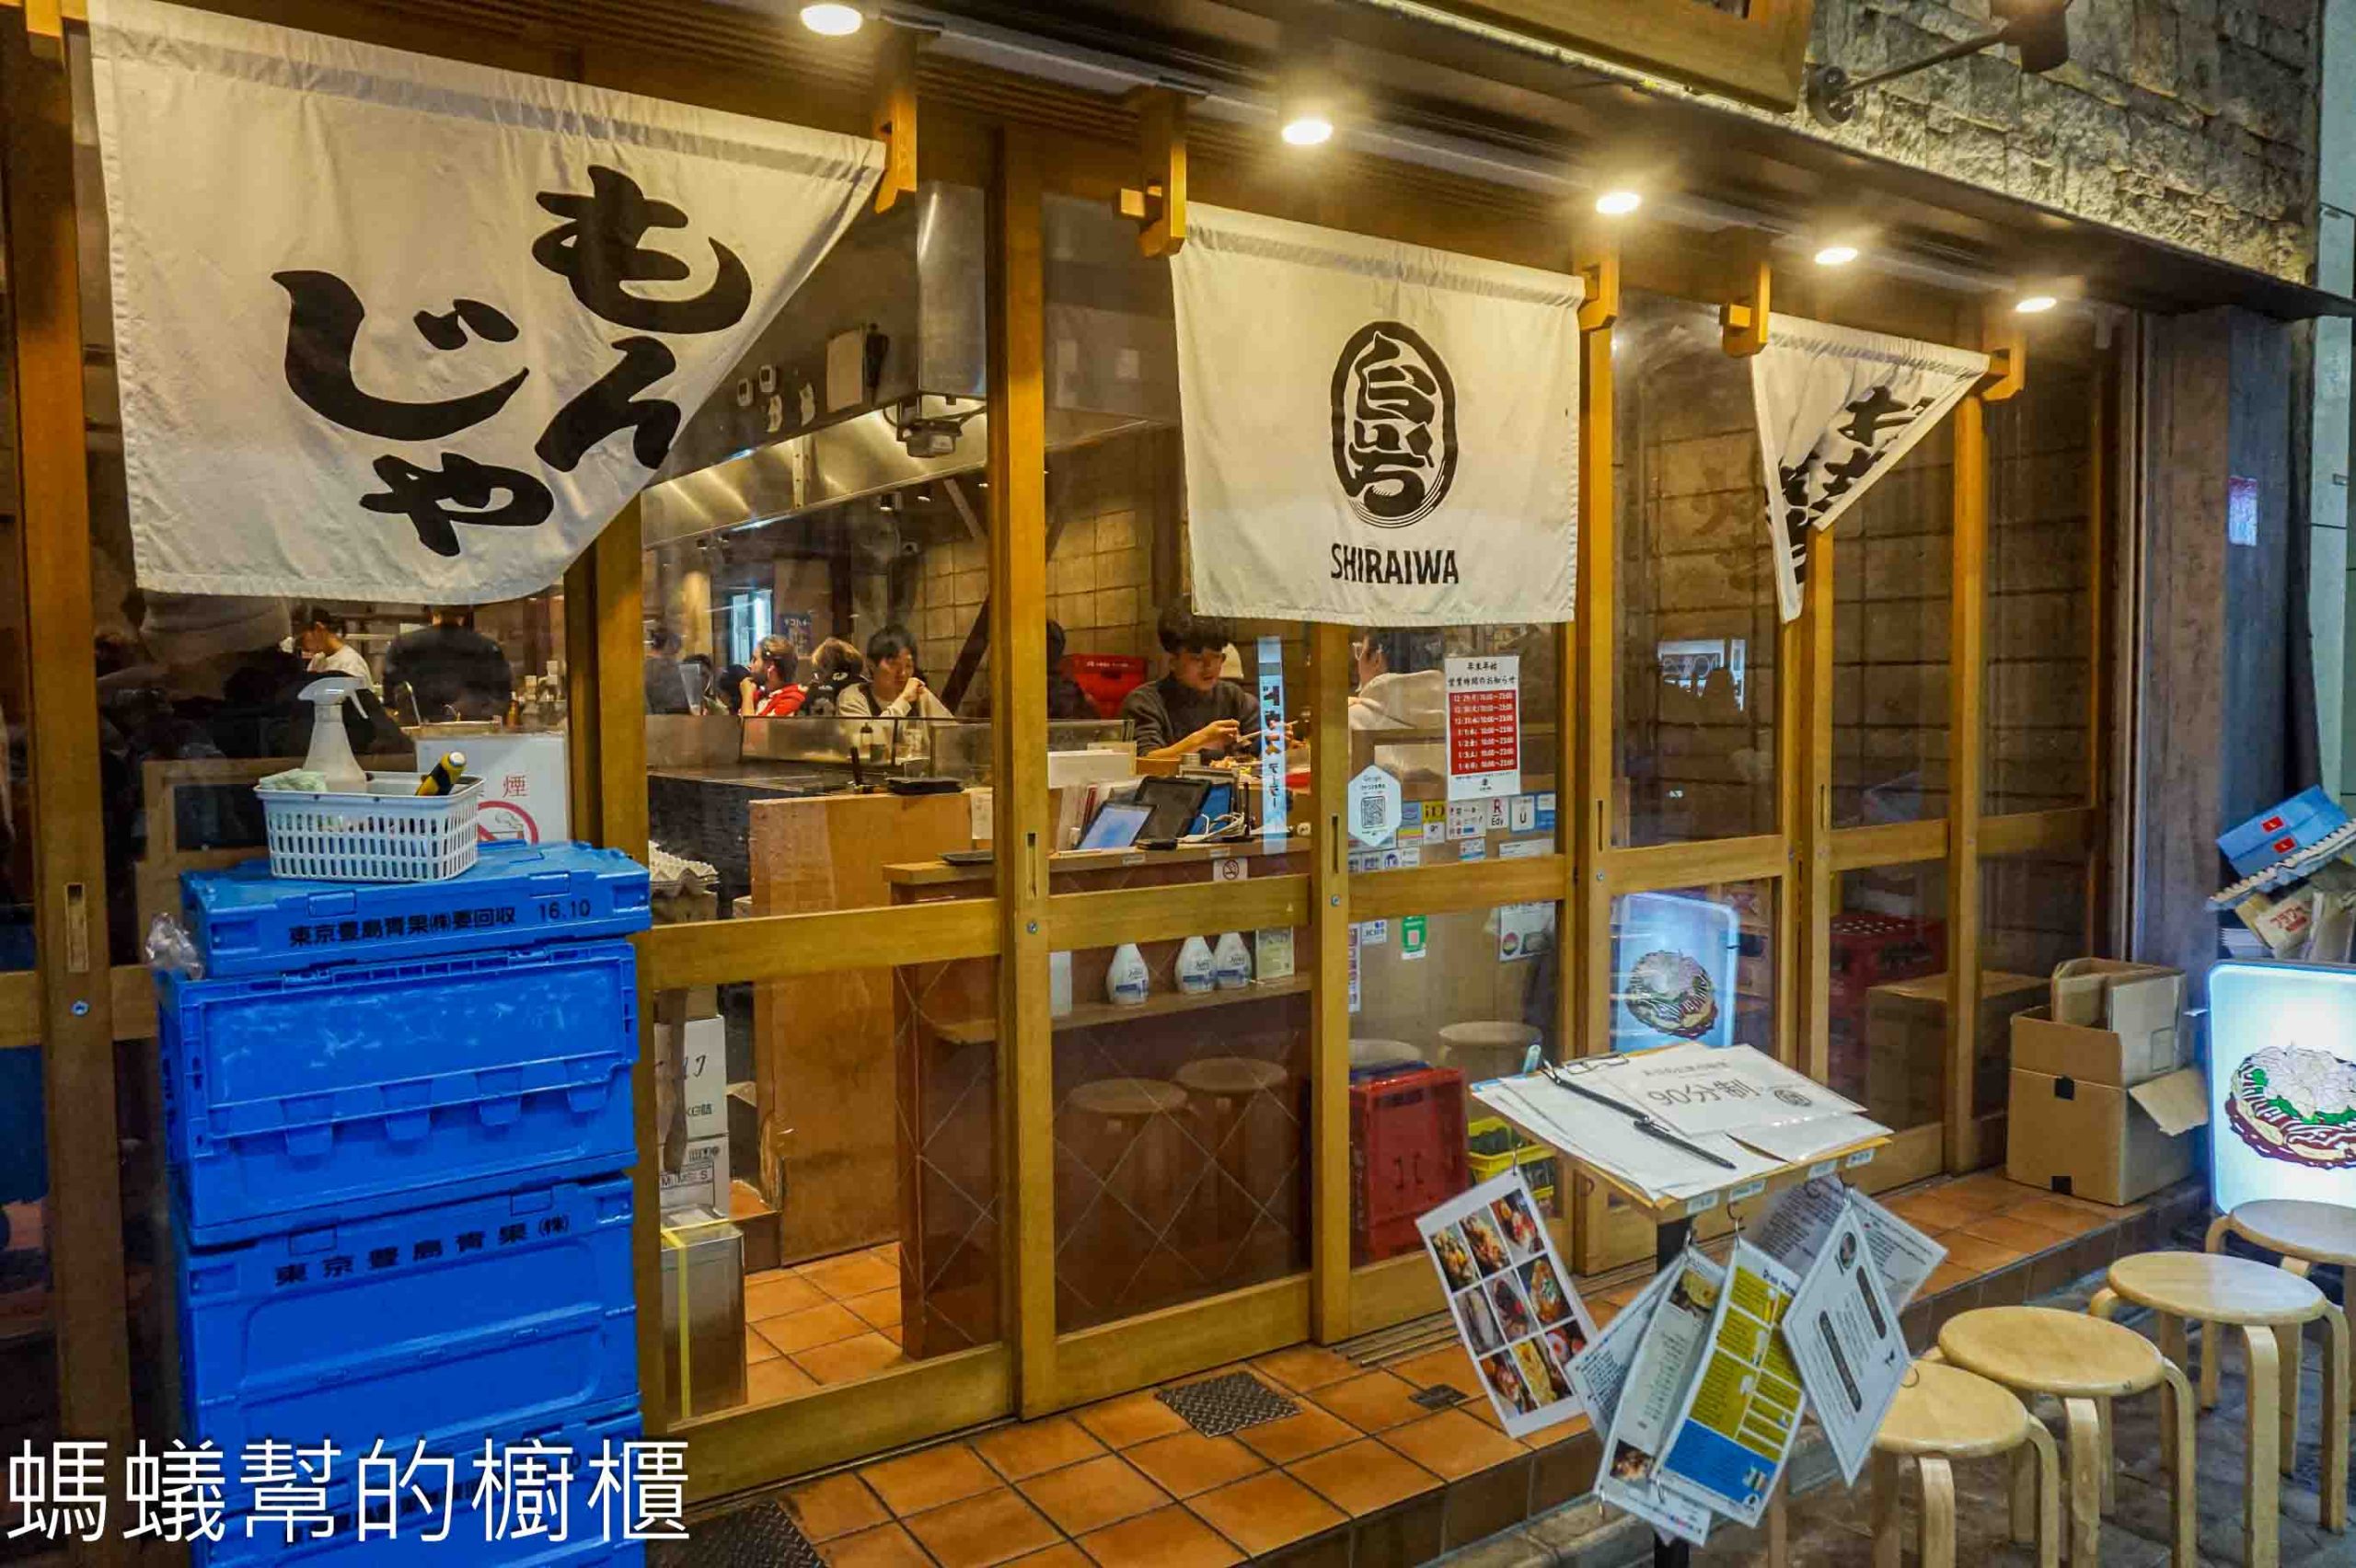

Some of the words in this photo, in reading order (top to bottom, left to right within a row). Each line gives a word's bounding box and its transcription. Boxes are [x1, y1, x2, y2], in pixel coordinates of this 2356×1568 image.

[531, 164, 753, 473] もん
[271, 270, 556, 558] じゃ
[1330, 542, 1460, 585] SHIRAIWA
[537, 898, 592, 920] 16.10
[1647, 1078, 1761, 1106] 90分制
